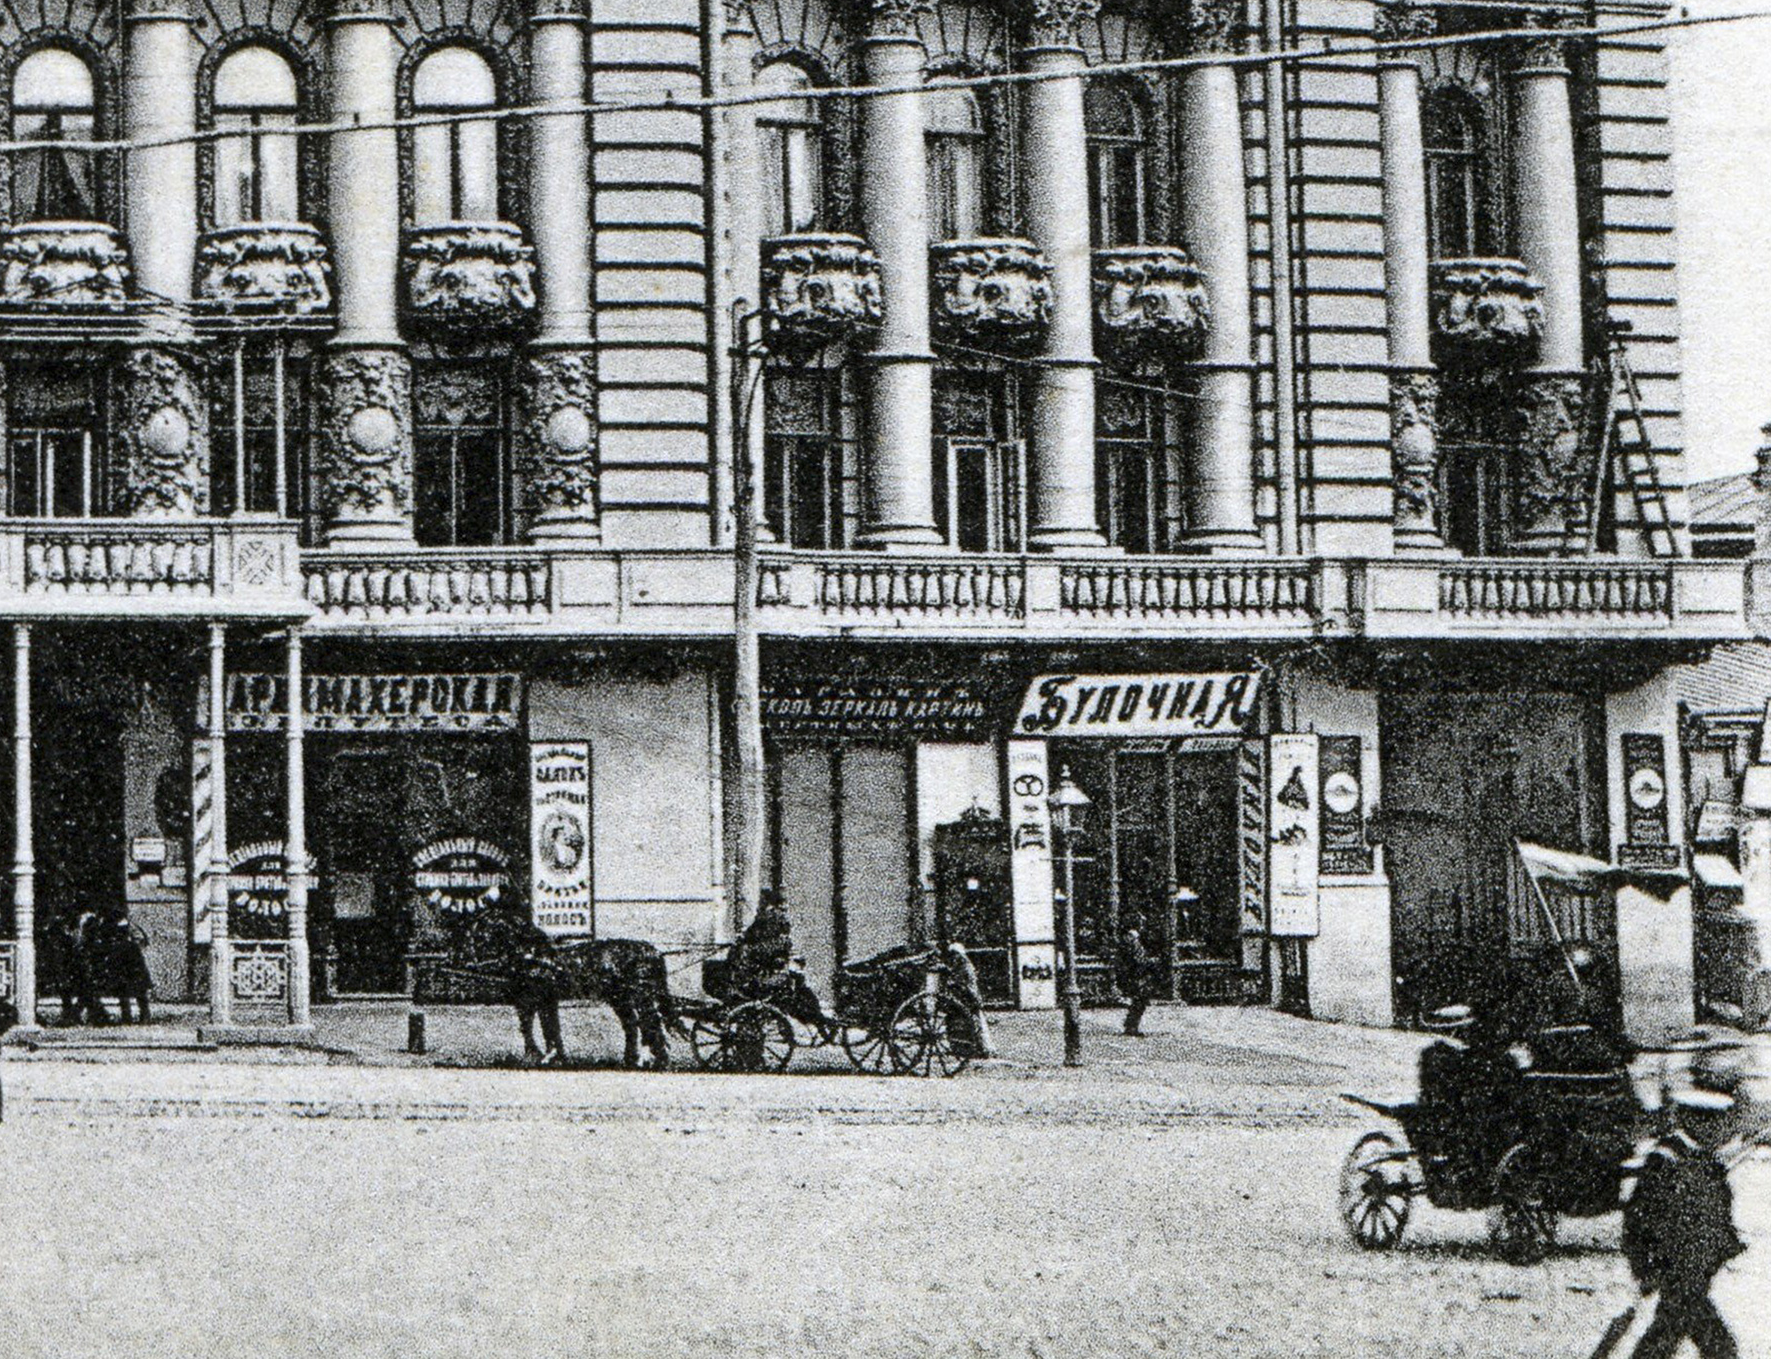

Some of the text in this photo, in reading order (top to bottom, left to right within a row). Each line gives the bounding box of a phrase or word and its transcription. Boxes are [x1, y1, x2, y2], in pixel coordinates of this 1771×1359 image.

[228, 674, 515, 714] АРИМАХЕРСКАЯ
[730, 697, 813, 716] СКОЛЪ
[1022, 674, 1251, 732] БУЛОЧНАЯ
